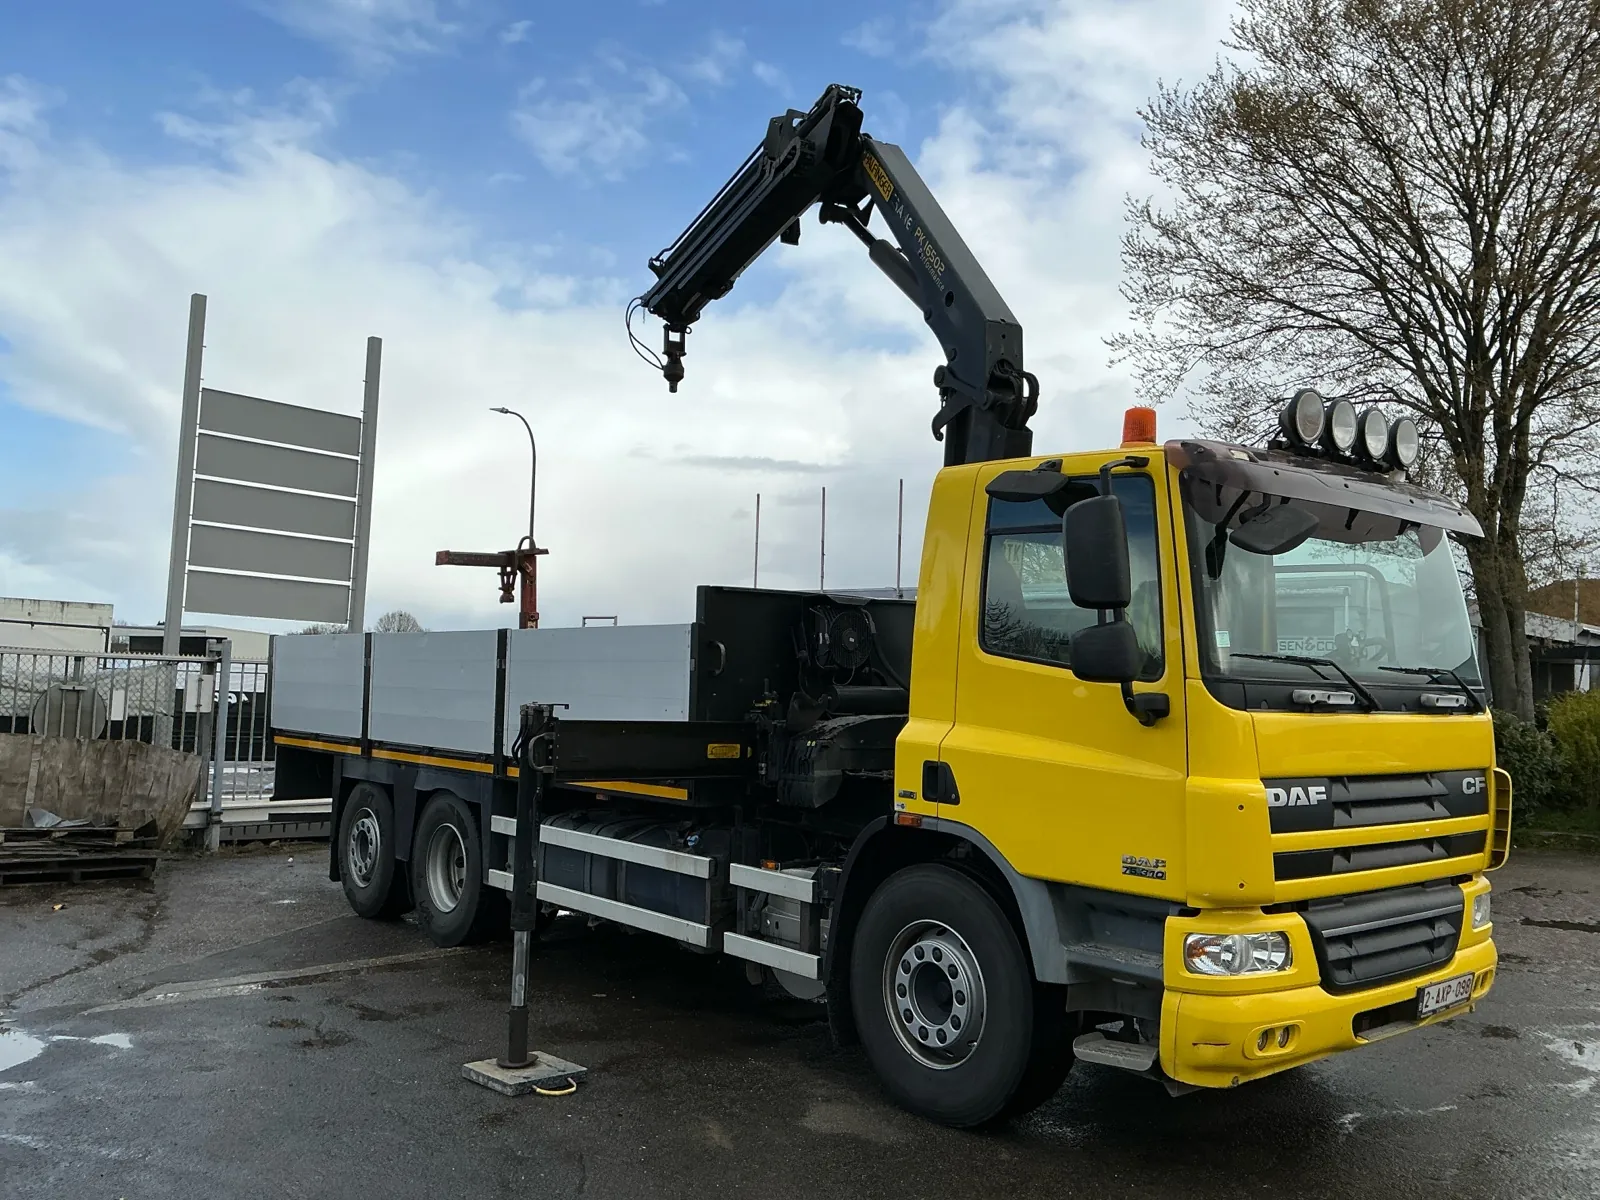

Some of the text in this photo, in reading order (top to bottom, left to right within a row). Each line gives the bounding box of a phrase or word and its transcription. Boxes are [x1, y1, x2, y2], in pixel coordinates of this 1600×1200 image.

[917, 247, 945, 291] Performance
[923, 241, 945, 276] 16502
[1462, 777, 1486, 794] CF
[1266, 786, 1326, 807] DAF
[1122, 854, 1166, 868] DAF
